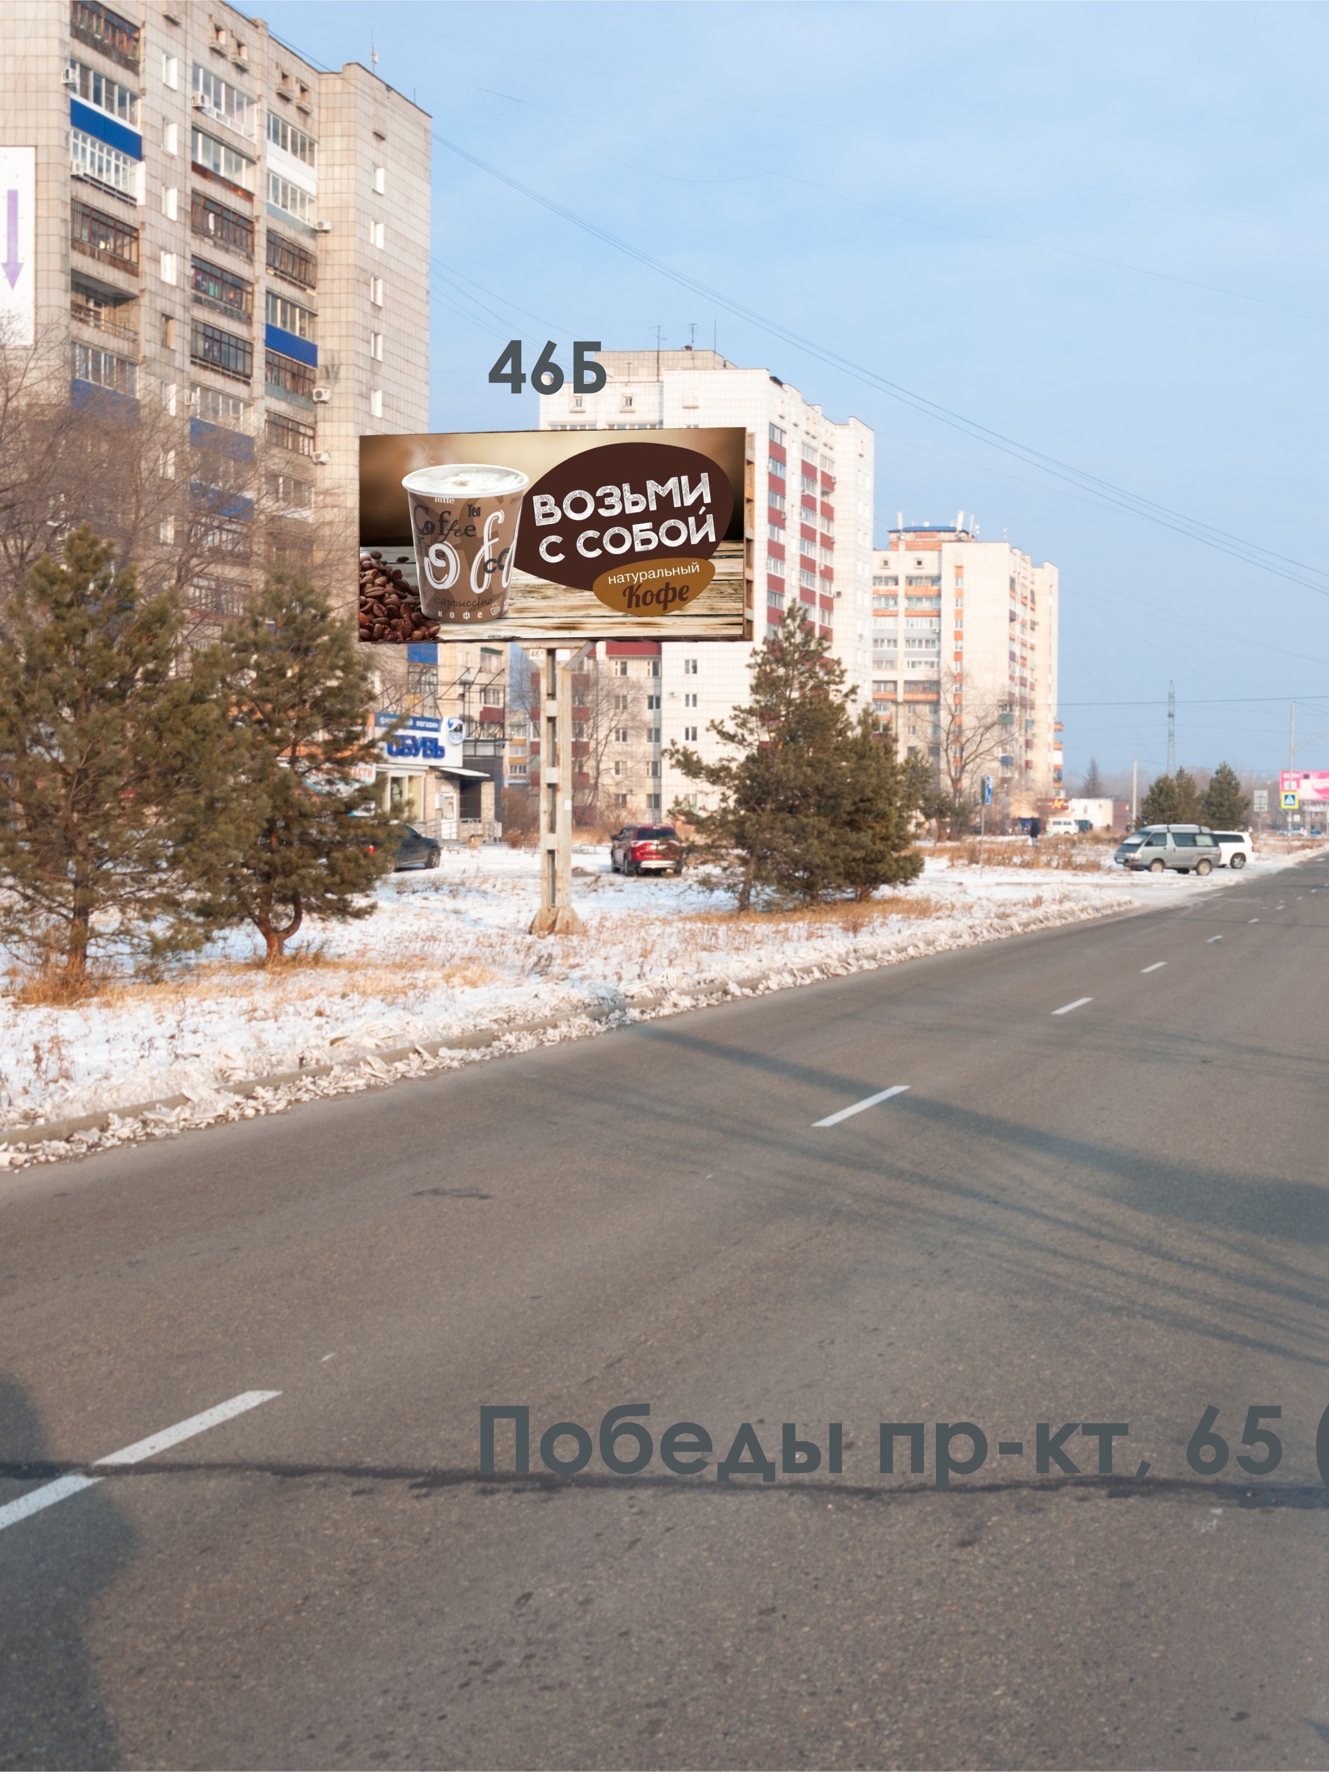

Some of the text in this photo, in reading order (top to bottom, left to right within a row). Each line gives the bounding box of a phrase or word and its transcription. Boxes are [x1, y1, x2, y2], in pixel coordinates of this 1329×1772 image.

[467, 504, 481, 518] Tea
[532, 472, 712, 527] ВОЗЬМИ
[413, 504, 476, 543] Coffee
[538, 534, 566, 564] С
[576, 506, 717, 559] СОБОЙ
[608, 561, 701, 585] натуральный
[434, 596, 493, 610] cappuccino
[622, 581, 690, 612] Кофе
